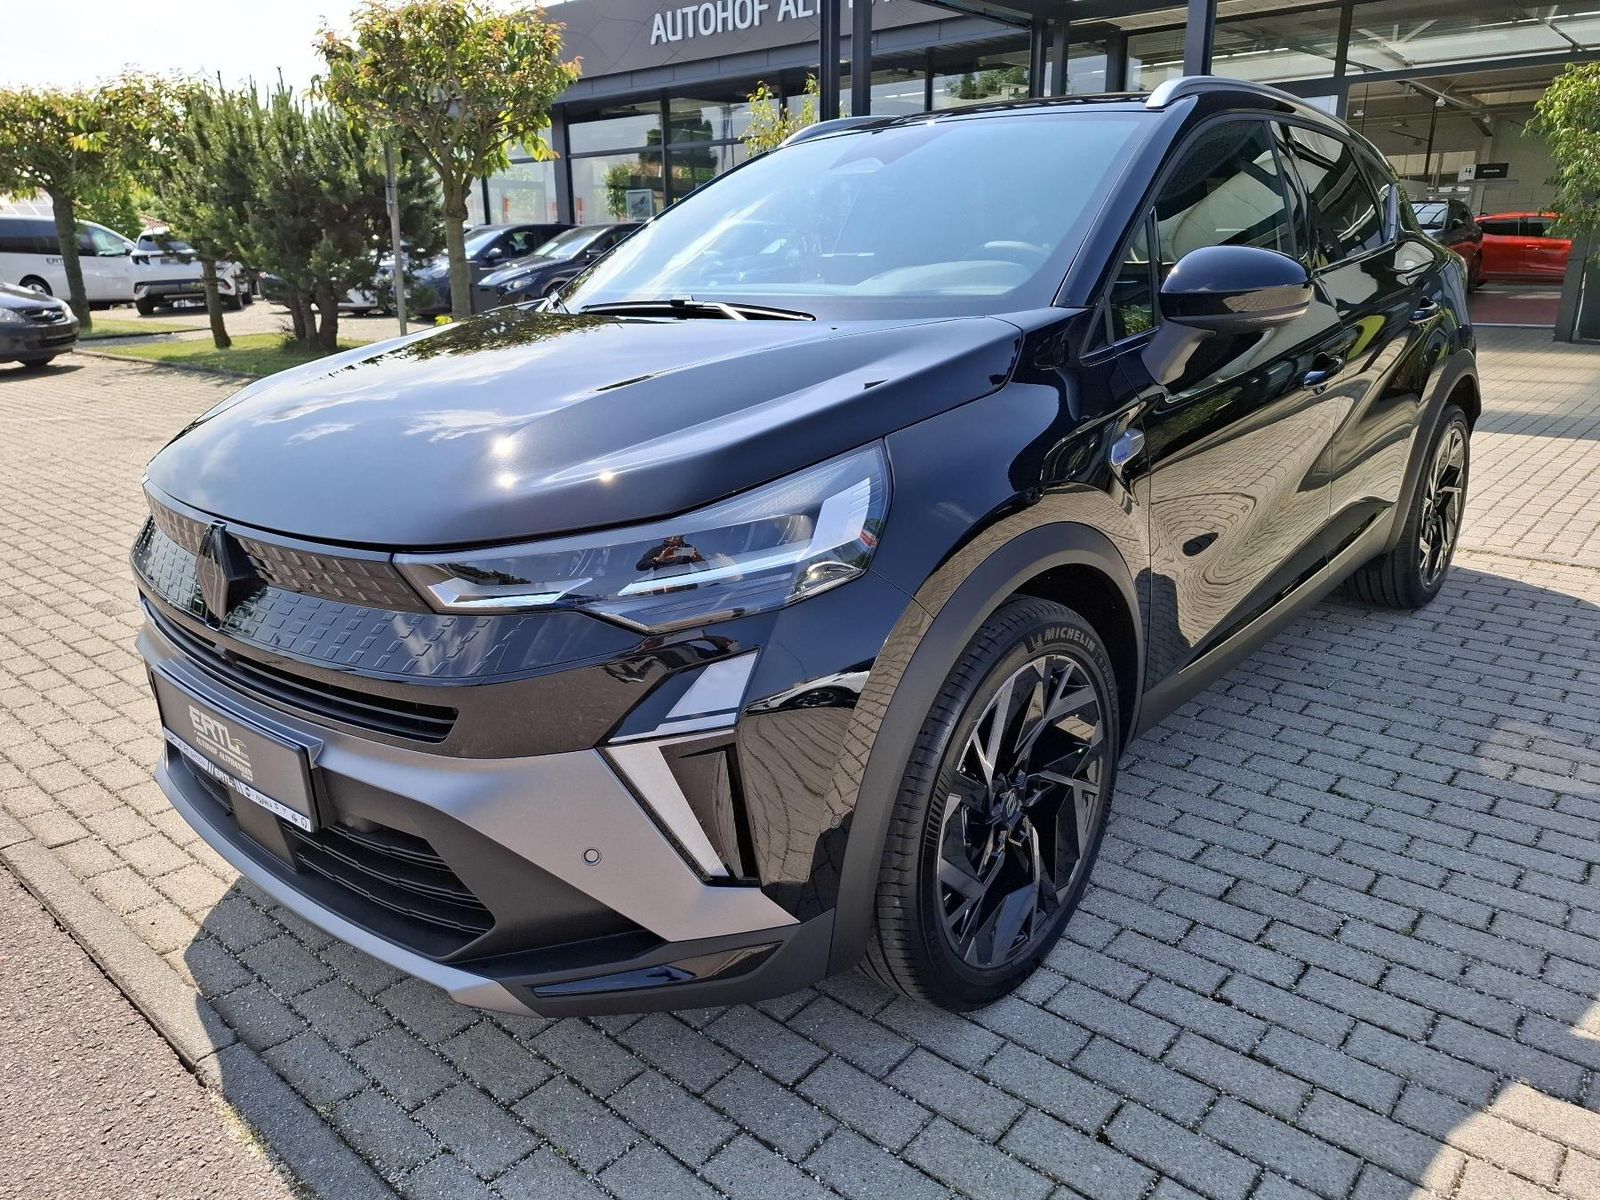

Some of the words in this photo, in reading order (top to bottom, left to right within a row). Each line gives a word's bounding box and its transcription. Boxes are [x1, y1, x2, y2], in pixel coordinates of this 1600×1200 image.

[650, 0, 769, 45] AUTOHOF
[1045, 627, 1096, 652] MICHELIN
[188, 705, 240, 755] ERTL
